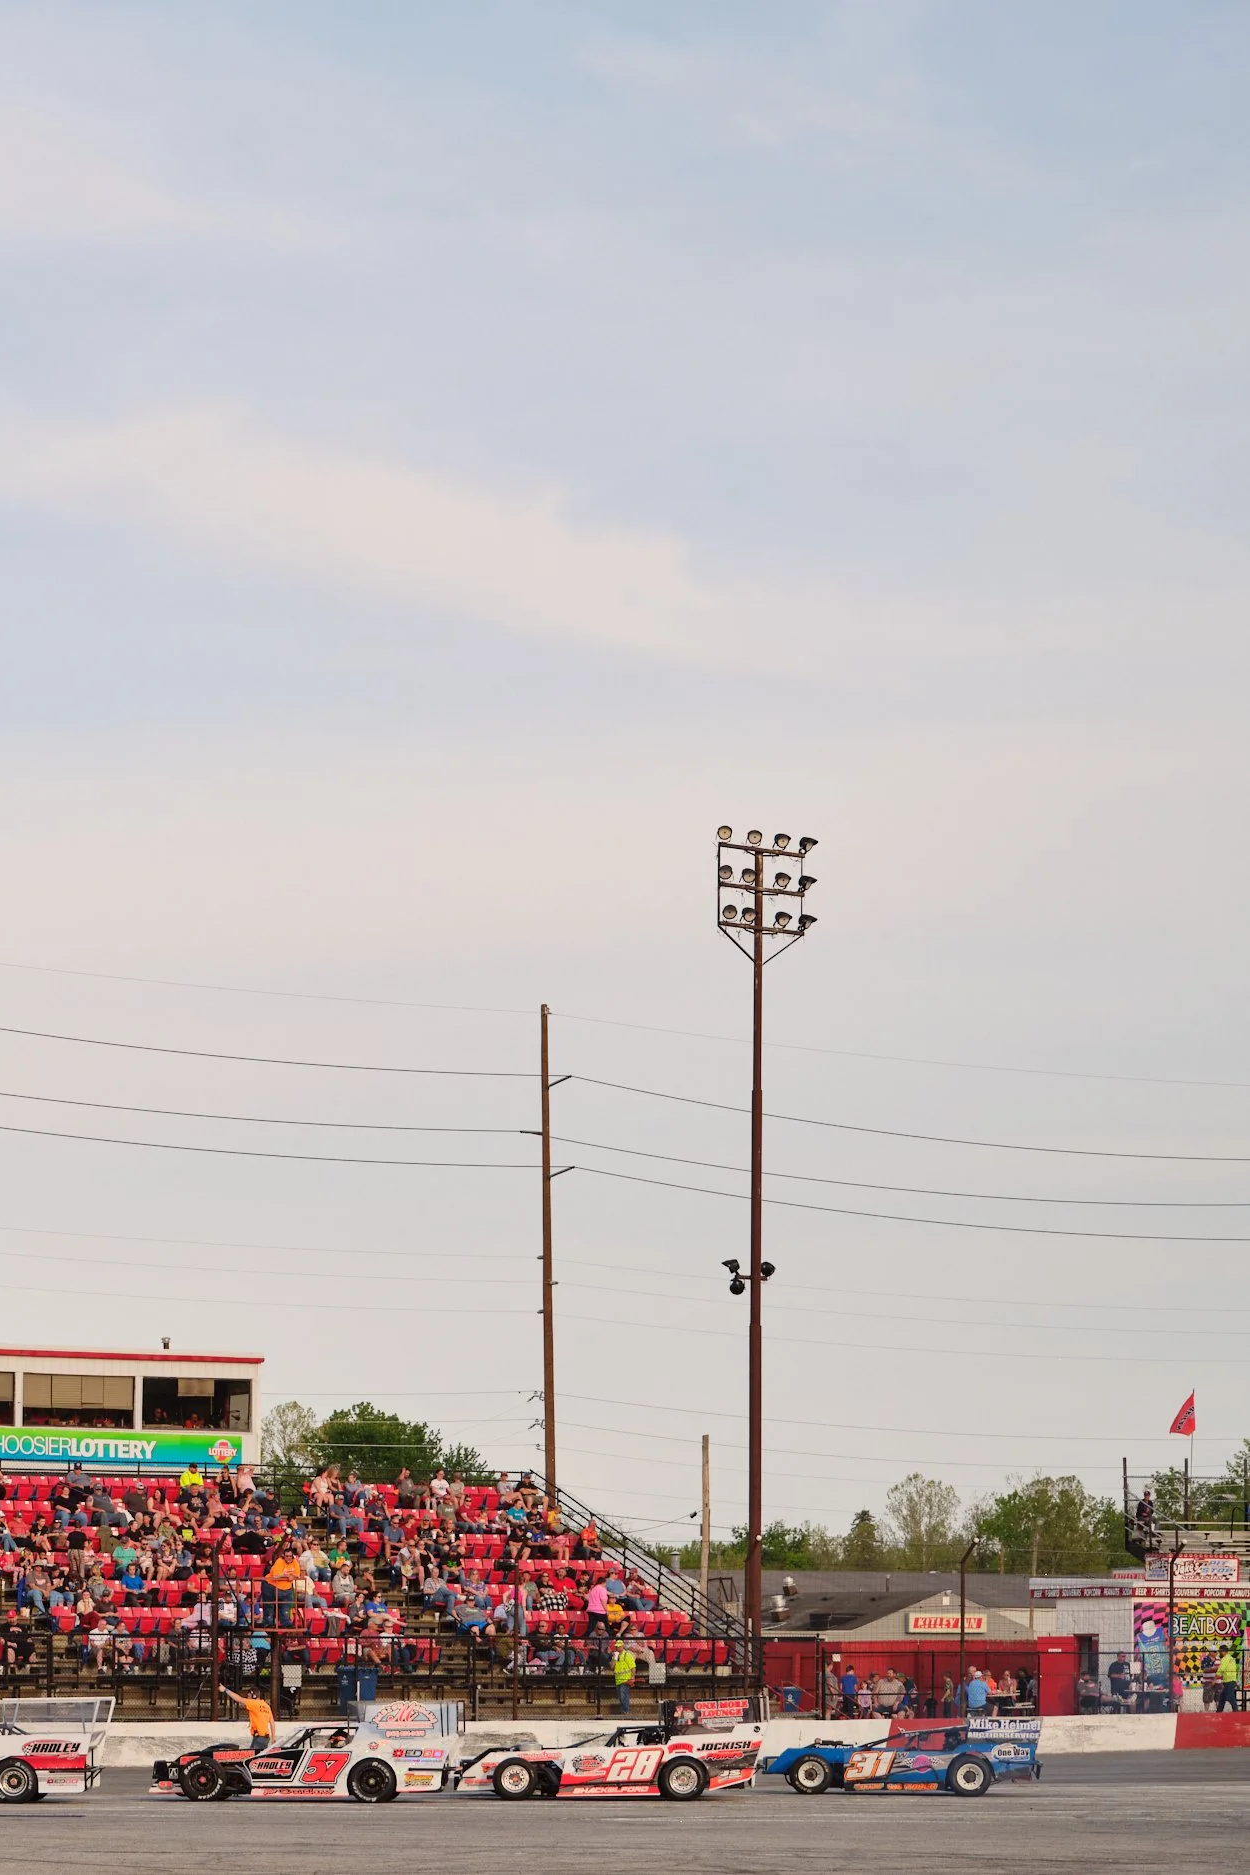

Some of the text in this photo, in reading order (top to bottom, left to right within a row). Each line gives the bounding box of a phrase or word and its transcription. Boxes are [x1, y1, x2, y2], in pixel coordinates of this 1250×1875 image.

[70, 1438, 156, 1459] LOTTERY
[208, 1448, 238, 1457] LOTTERY
[1135, 1588, 1250, 1597] BEER T-SHIRTS SOUVENIRS POPCORN PEANUTS
[914, 1617, 959, 1628] KITLEY
[1172, 1617, 1238, 1634] BEATBOX
[695, 1700, 749, 1710] ONE MORE
[701, 1709, 743, 1717] LOUNGE
[969, 1719, 1041, 1731] Mike Heimel
[31, 1742, 81, 1753] HADLEY
[1013, 1749, 1029, 1757] Way
[257, 1761, 293, 1770] HADLEY
[300, 1752, 351, 1784] 57
[605, 1750, 663, 1782] 28
[844, 1750, 897, 1781] 31
[572, 1786, 649, 1794] SHACKELFORD
